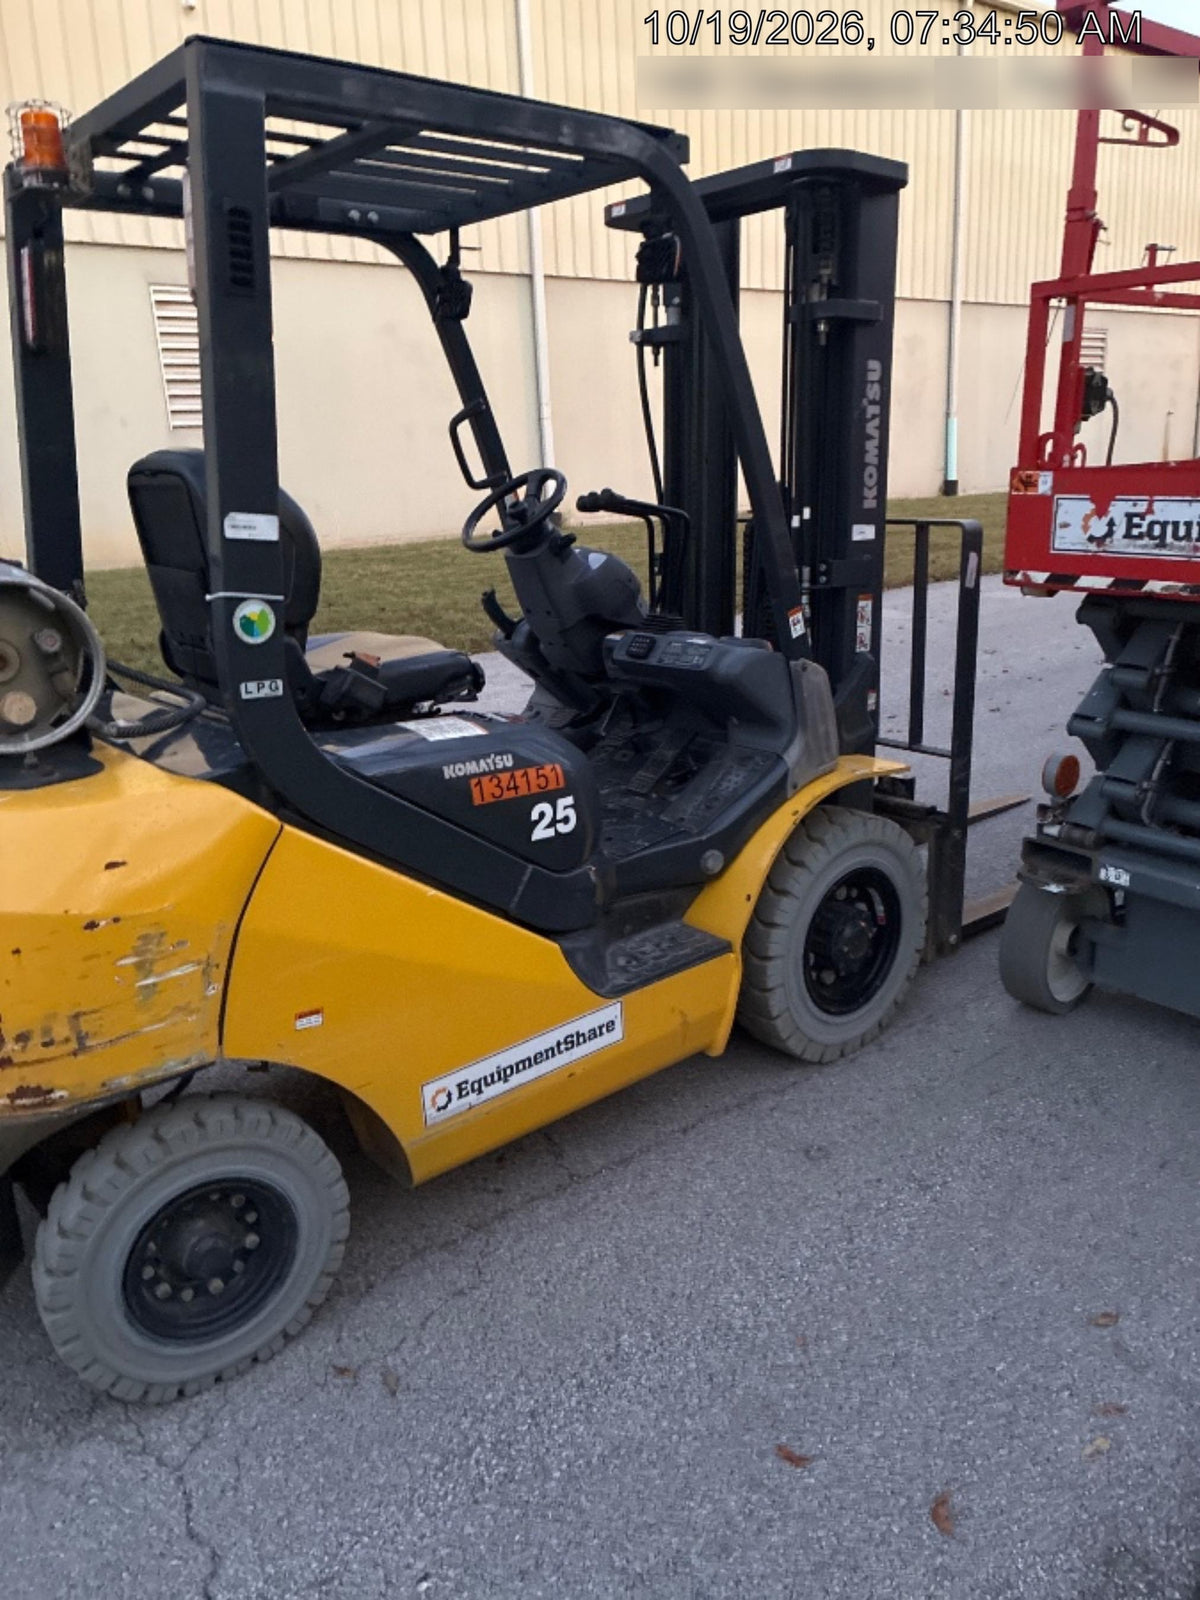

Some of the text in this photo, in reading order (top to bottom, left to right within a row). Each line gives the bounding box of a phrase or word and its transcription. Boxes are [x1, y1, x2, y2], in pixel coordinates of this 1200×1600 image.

[863, 359, 882, 509] KOMATSU
[442, 753, 514, 779] KOMATSU
[473, 765, 561, 802] 134151
[531, 795, 577, 841] 25
[456, 1019, 616, 1100] EquipmentShare
